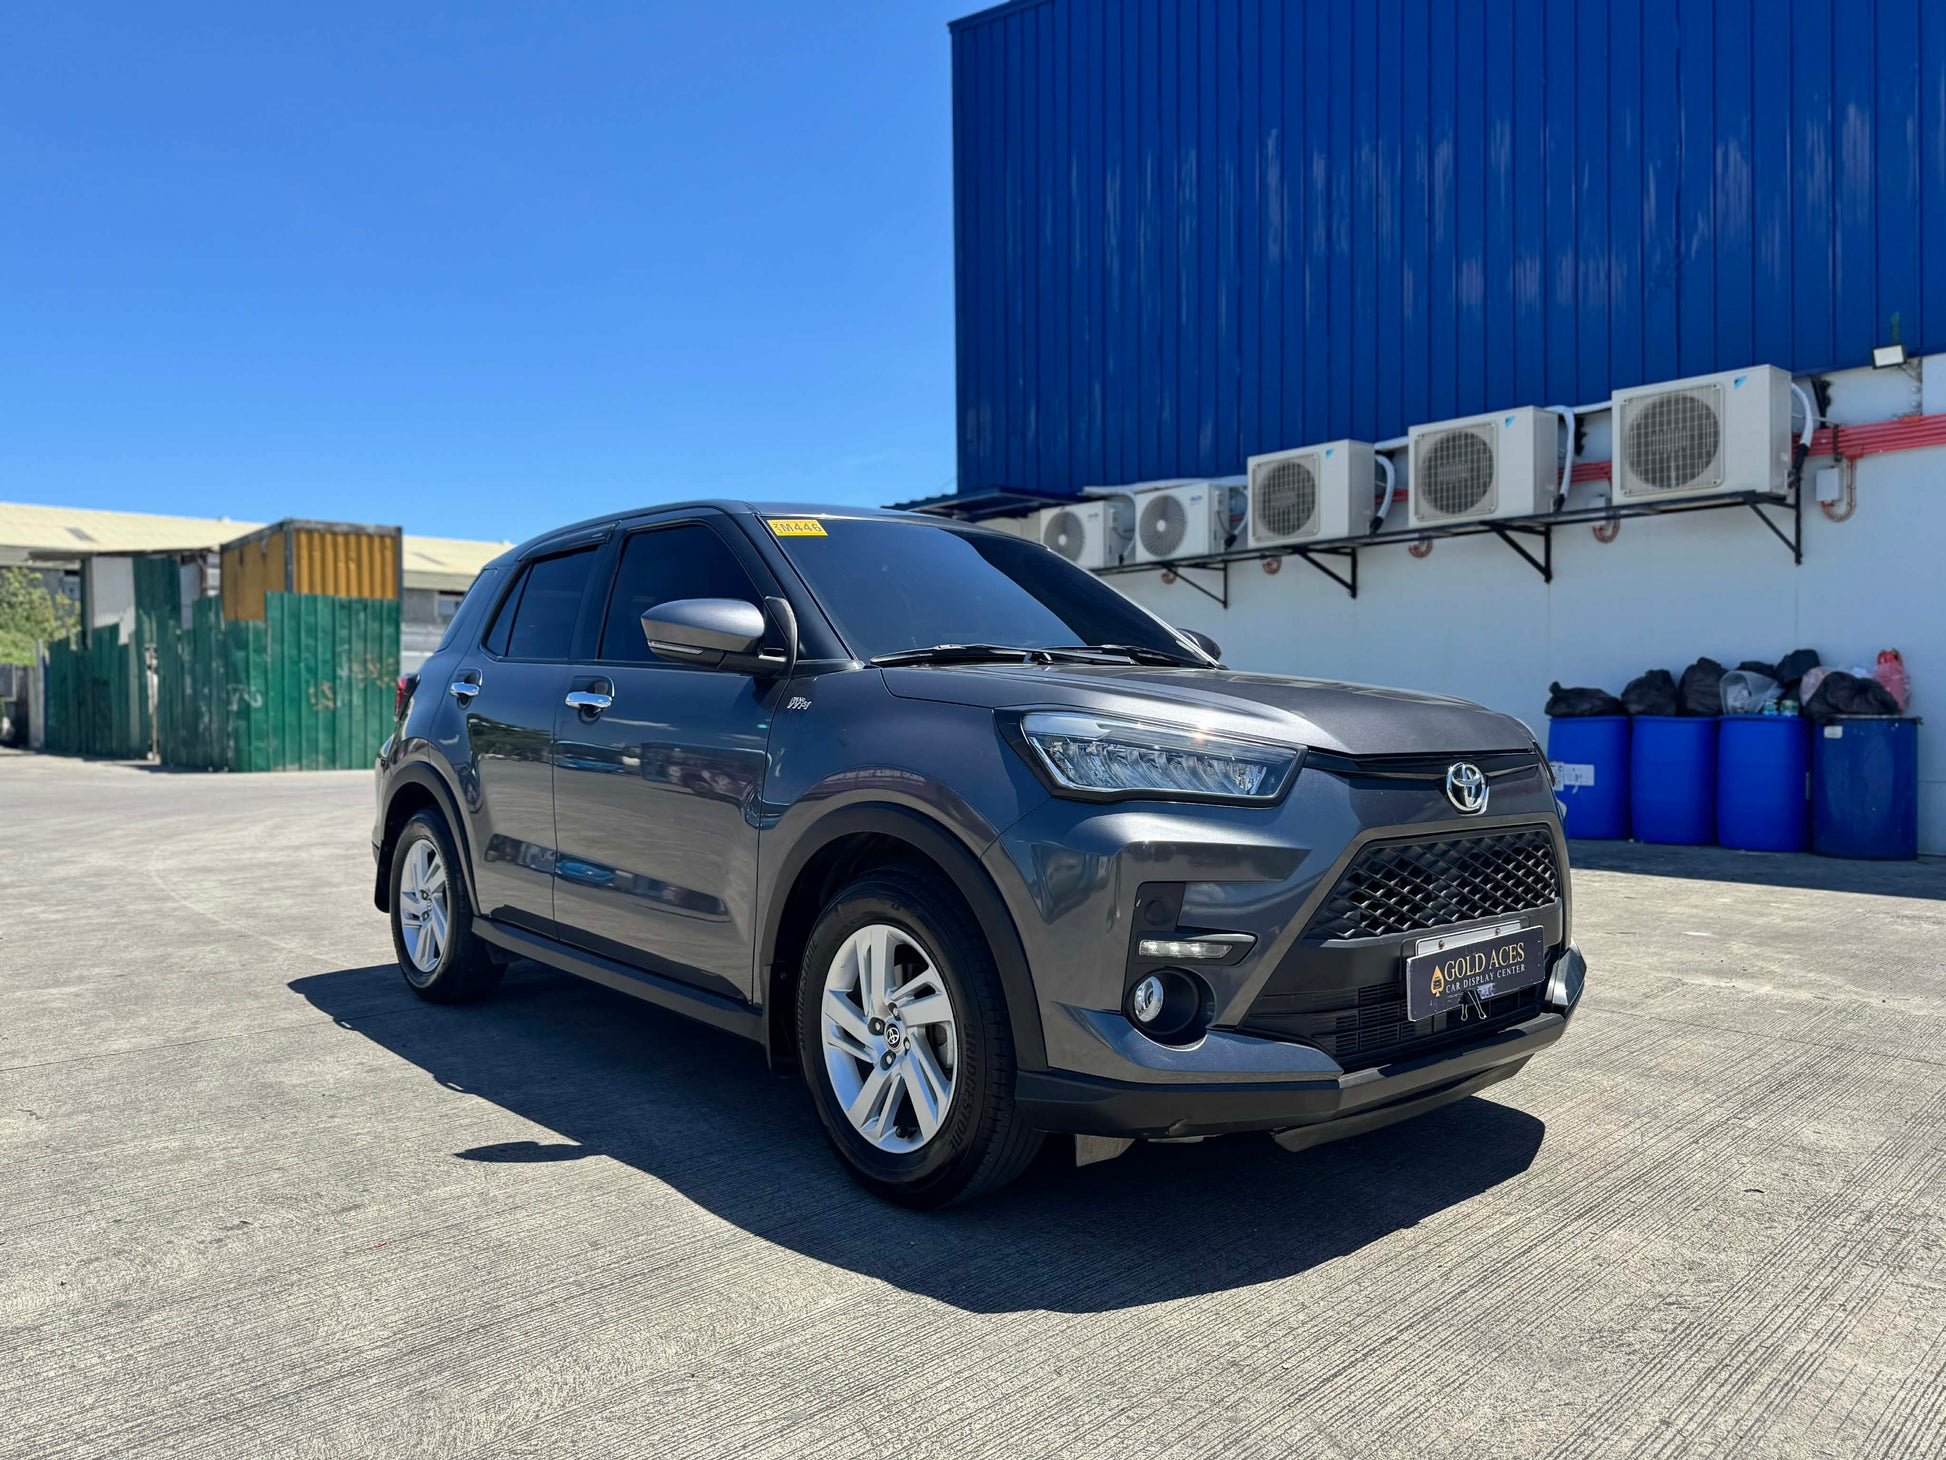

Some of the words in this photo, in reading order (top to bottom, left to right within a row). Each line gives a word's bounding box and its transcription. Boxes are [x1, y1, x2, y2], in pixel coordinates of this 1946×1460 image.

[1444, 953, 1486, 981] GOLD
[1489, 942, 1525, 969] ACES
[1446, 982, 1461, 994] CAR
[1463, 972, 1494, 988] DISPLAY
[1497, 963, 1526, 978] CENTER
